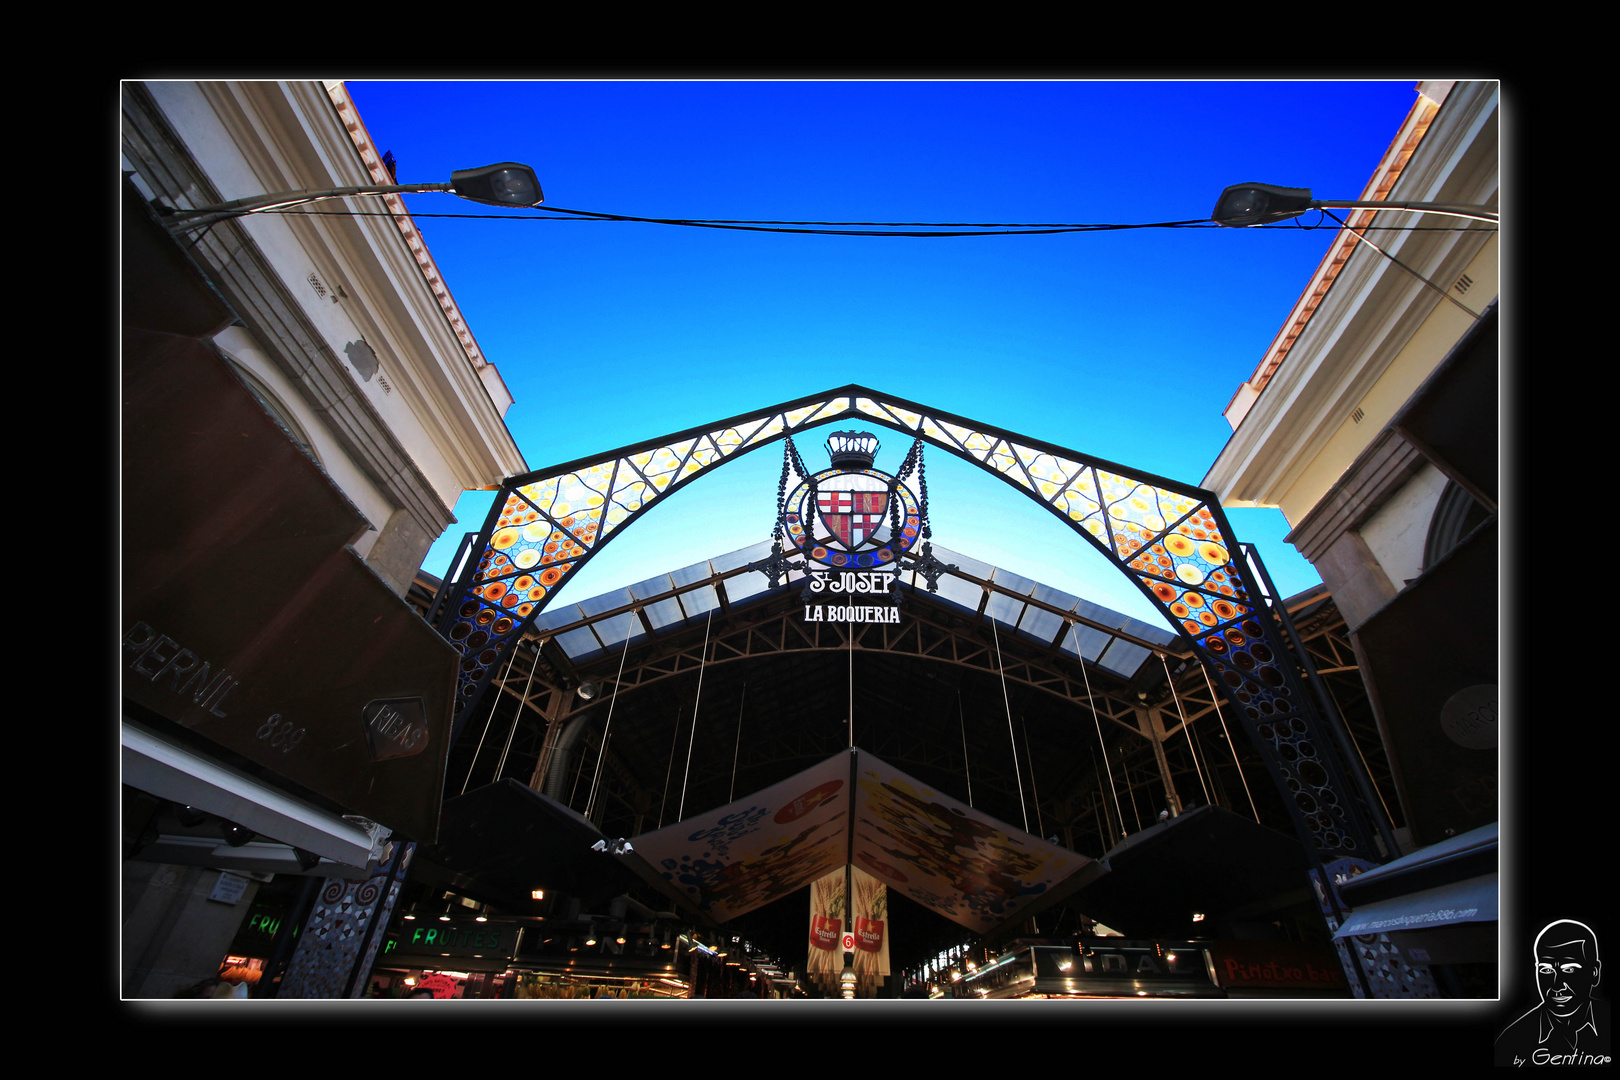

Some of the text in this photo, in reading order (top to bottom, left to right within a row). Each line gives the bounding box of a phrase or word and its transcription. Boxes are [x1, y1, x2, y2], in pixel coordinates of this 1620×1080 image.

[829, 572, 896, 593] JOSEP
[804, 605, 900, 623] LA BOQUERIA
[122, 620, 239, 718] PERNIL
[370, 703, 422, 749] RIBAS
[411, 927, 501, 949] FRUITES
[1050, 952, 1194, 974] VIDAL
